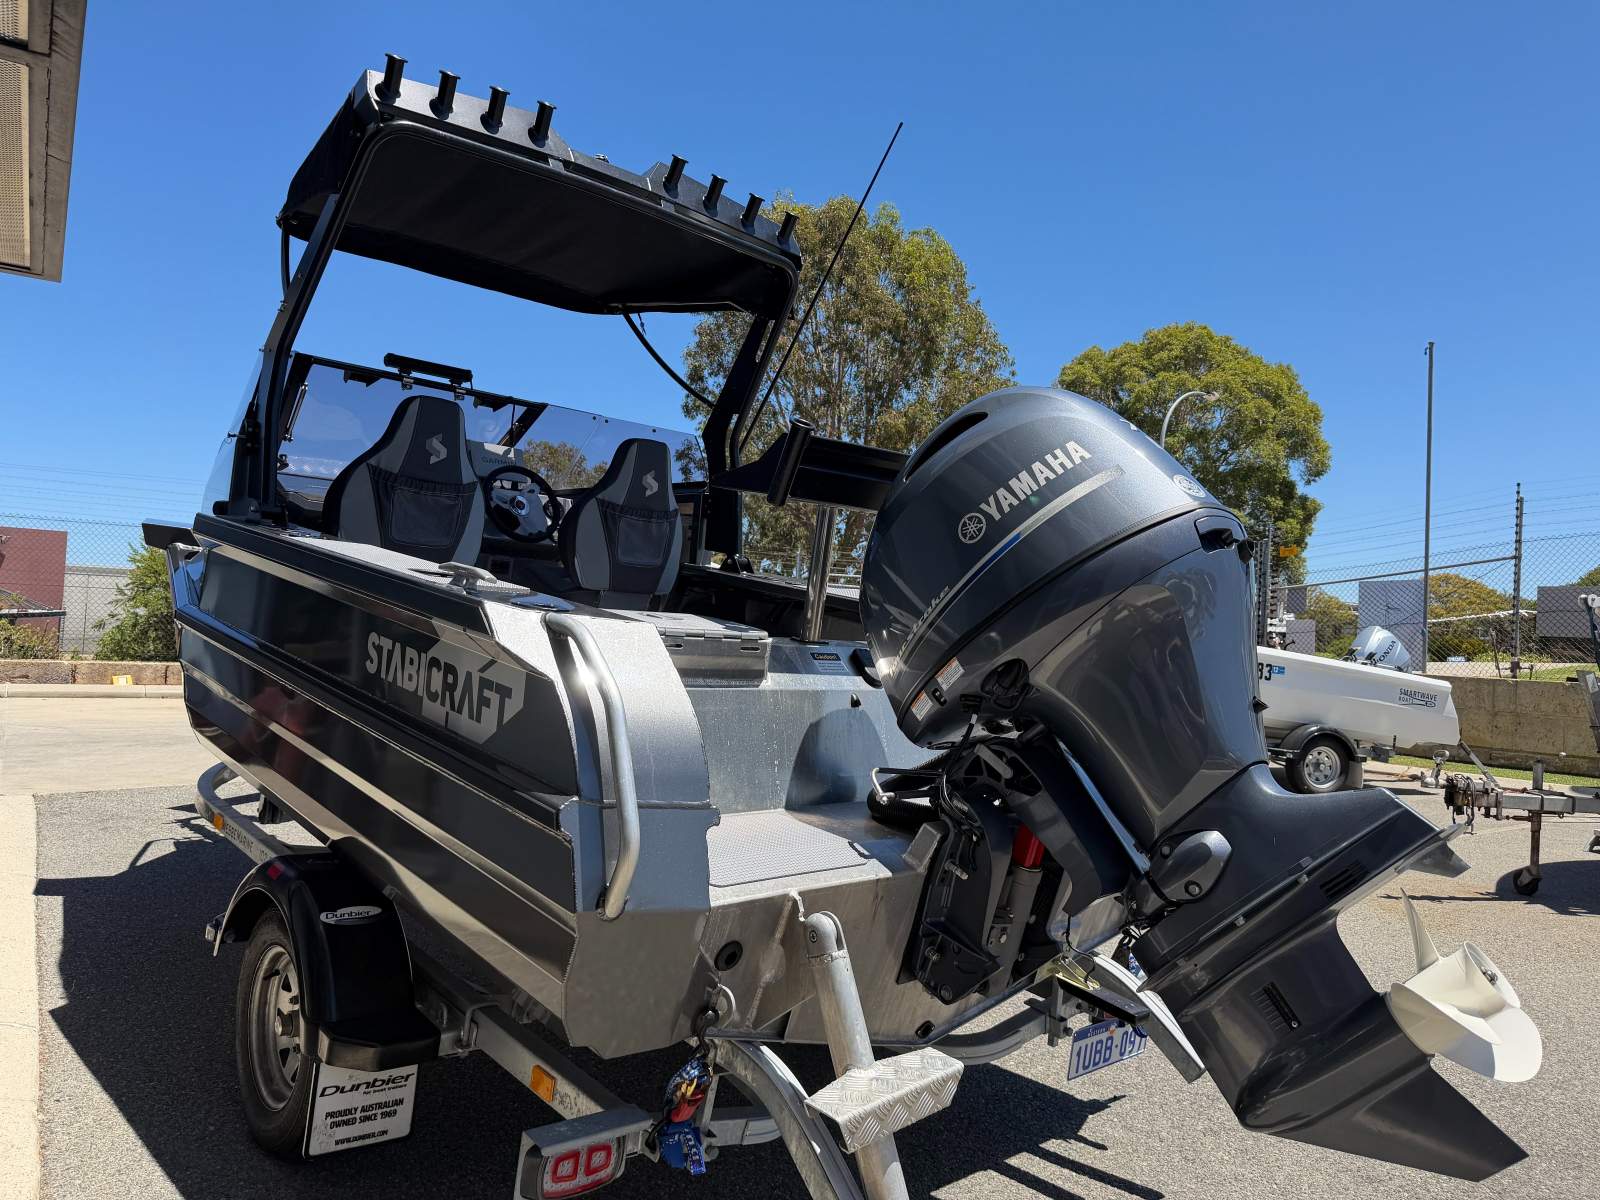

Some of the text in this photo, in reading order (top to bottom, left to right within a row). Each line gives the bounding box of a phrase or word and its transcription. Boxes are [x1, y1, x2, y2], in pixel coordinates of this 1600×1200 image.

[979, 440, 1092, 521] YAMAHA
[365, 631, 513, 727] STABICRAFT
[1398, 695, 1414, 705] BOATS
[1399, 687, 1438, 702] SMARTWAVE
[325, 910, 372, 920] Dunbier
[319, 1072, 416, 1098] Dunbier
[324, 1097, 405, 1120] PROUDLY AUSTRALIAN
[329, 1108, 398, 1130] OWNED SINCE 1969
[334, 1129, 389, 1146] WWW.DUNBIER.COM
